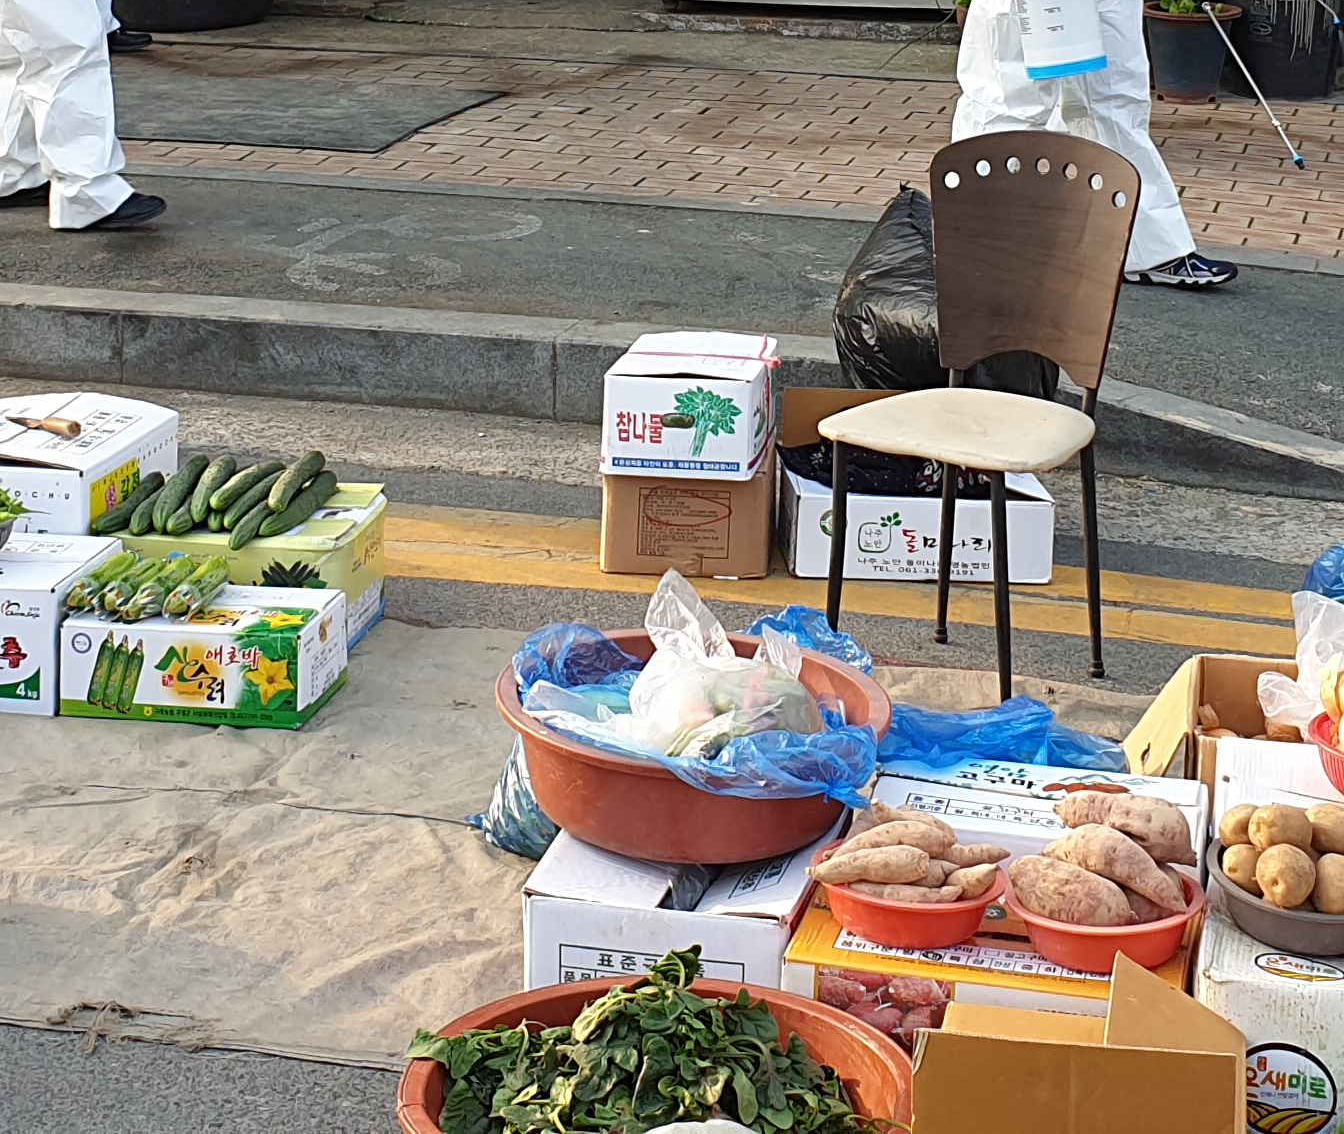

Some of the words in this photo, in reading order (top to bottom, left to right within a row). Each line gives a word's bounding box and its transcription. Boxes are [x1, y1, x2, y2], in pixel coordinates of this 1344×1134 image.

[616, 411, 664, 445] 참나물
[864, 528, 883, 538] 나주
[205, 645, 263, 668] 애호박
[16, 682, 27, 697] 4
[955, 770, 1037, 790] 고구마
